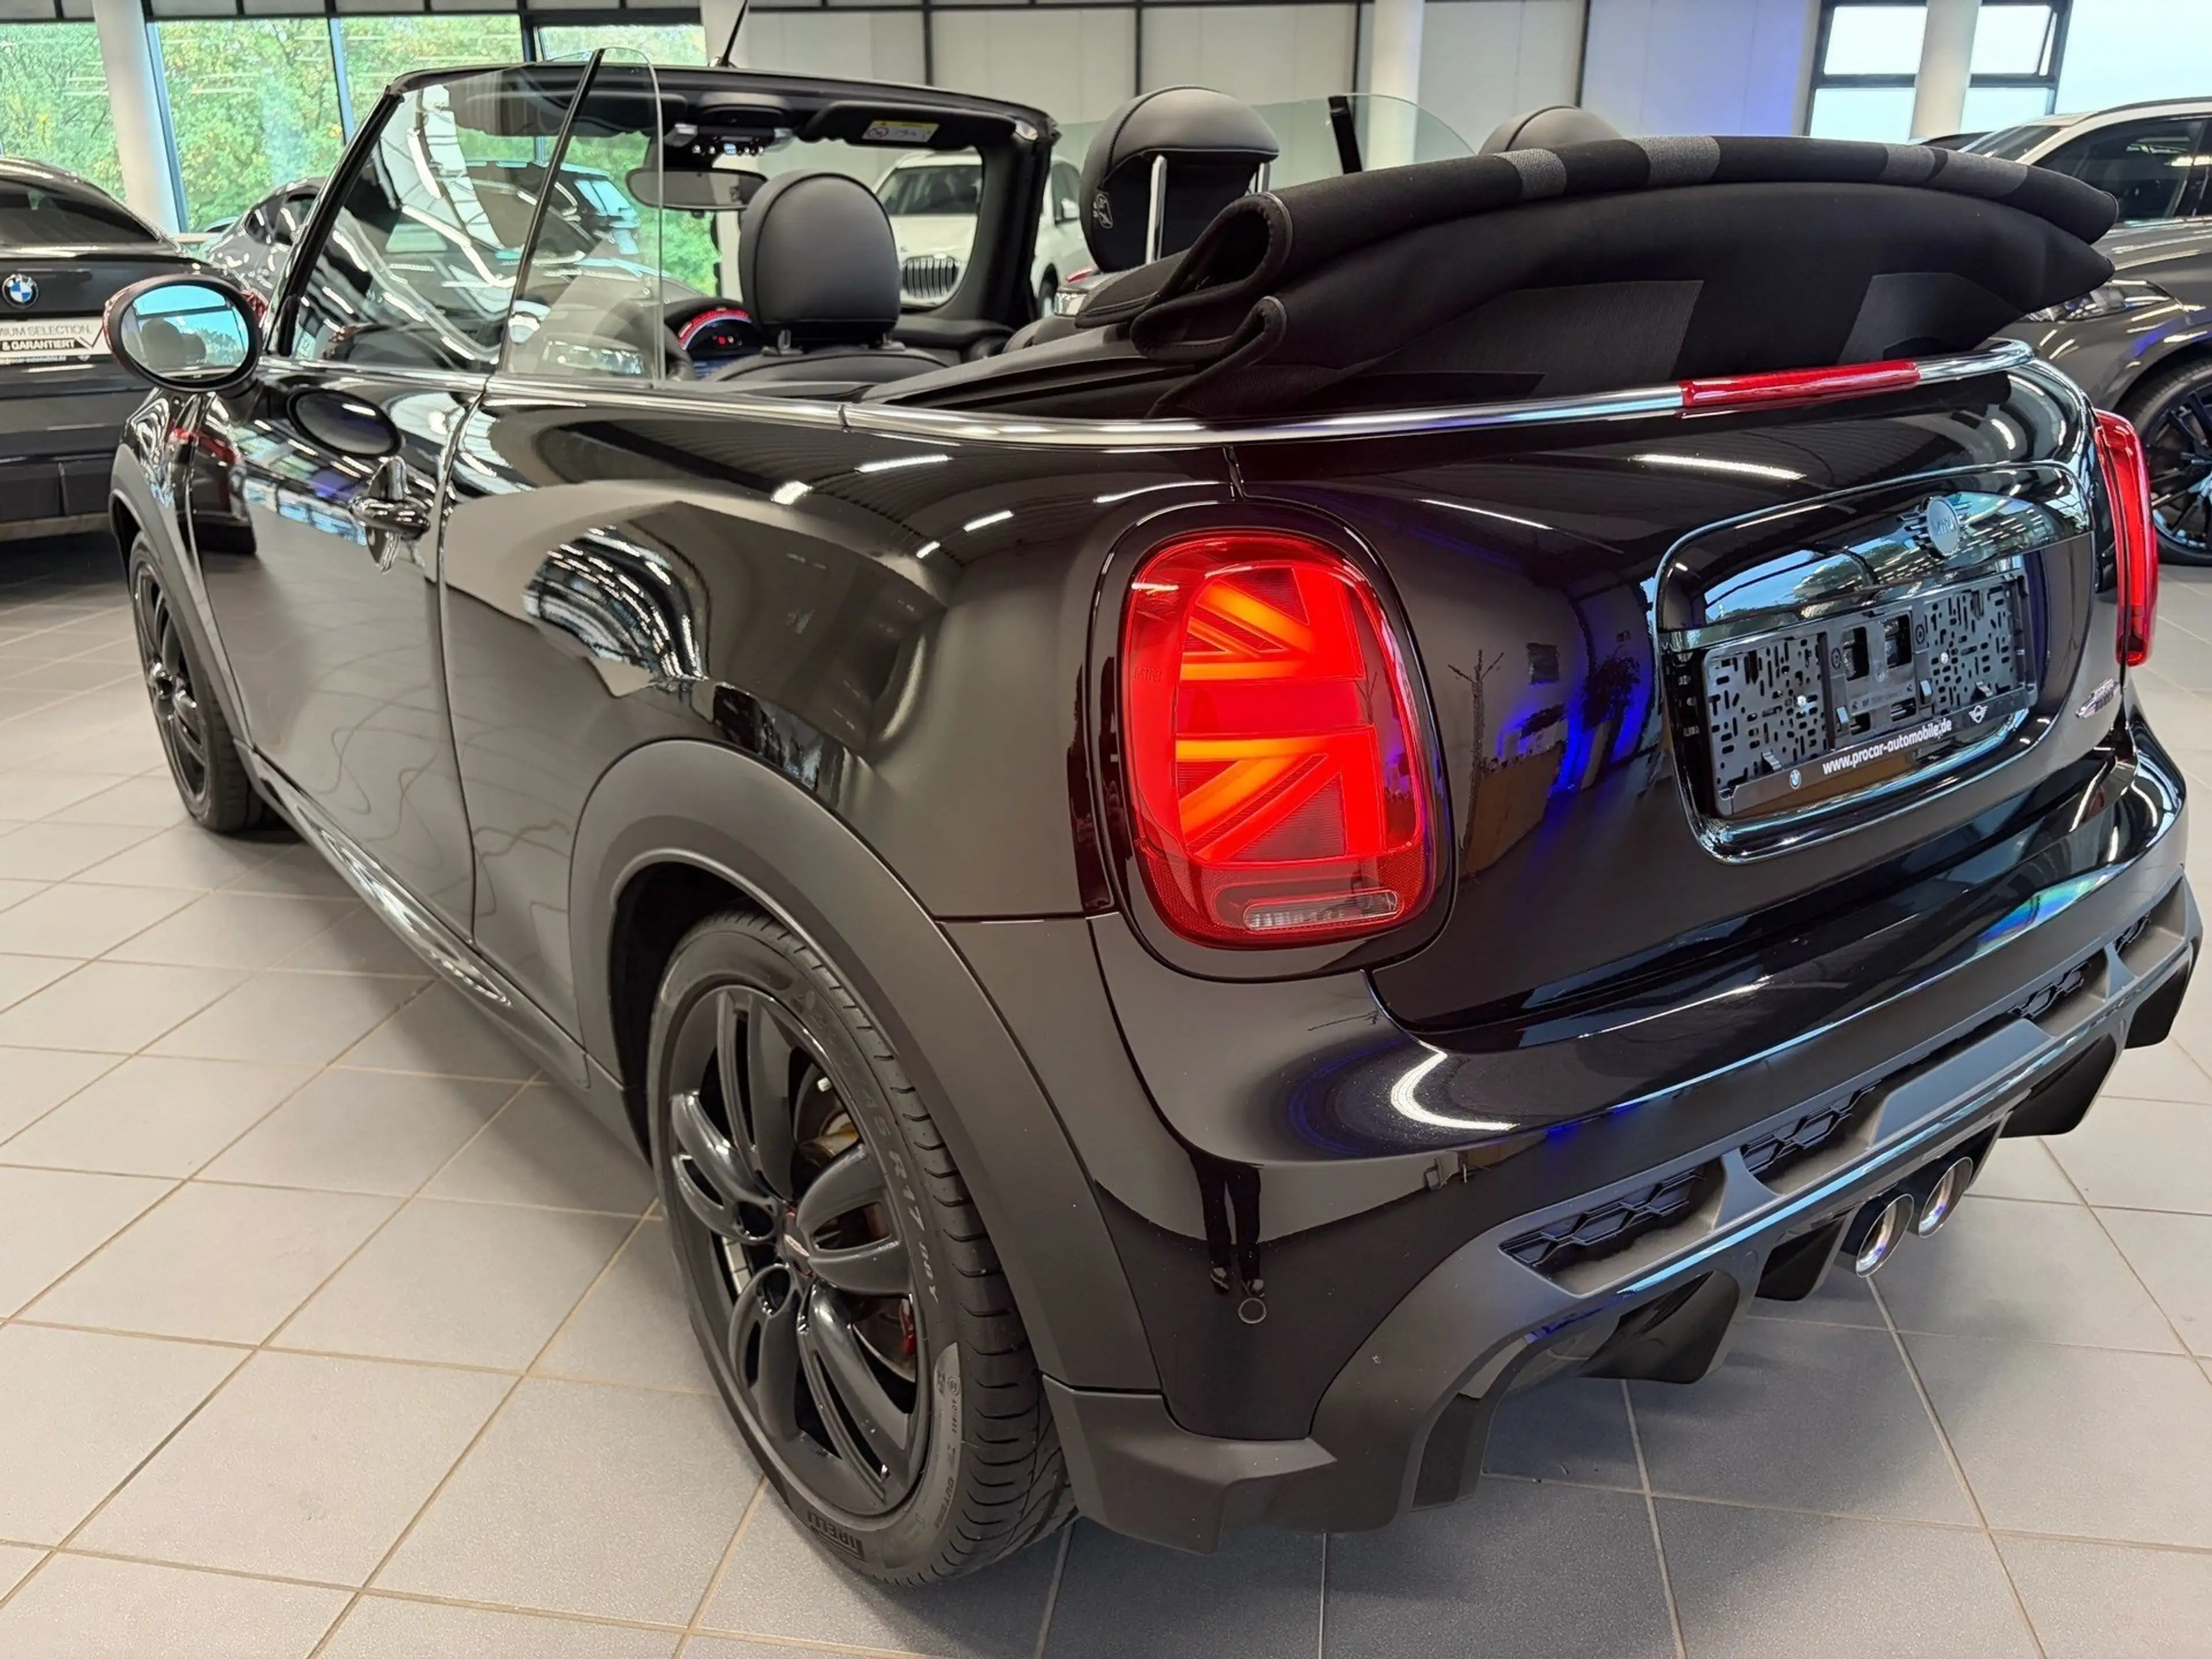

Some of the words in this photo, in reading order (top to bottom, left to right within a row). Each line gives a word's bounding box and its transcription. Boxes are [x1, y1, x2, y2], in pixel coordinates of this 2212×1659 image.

[2, 342, 10, 350] &
[12, 339, 75, 350] GARANTIERT
[1822, 718, 1952, 775] www.procar-automobile.de
[807, 1510, 865, 1560] PIRELLI
